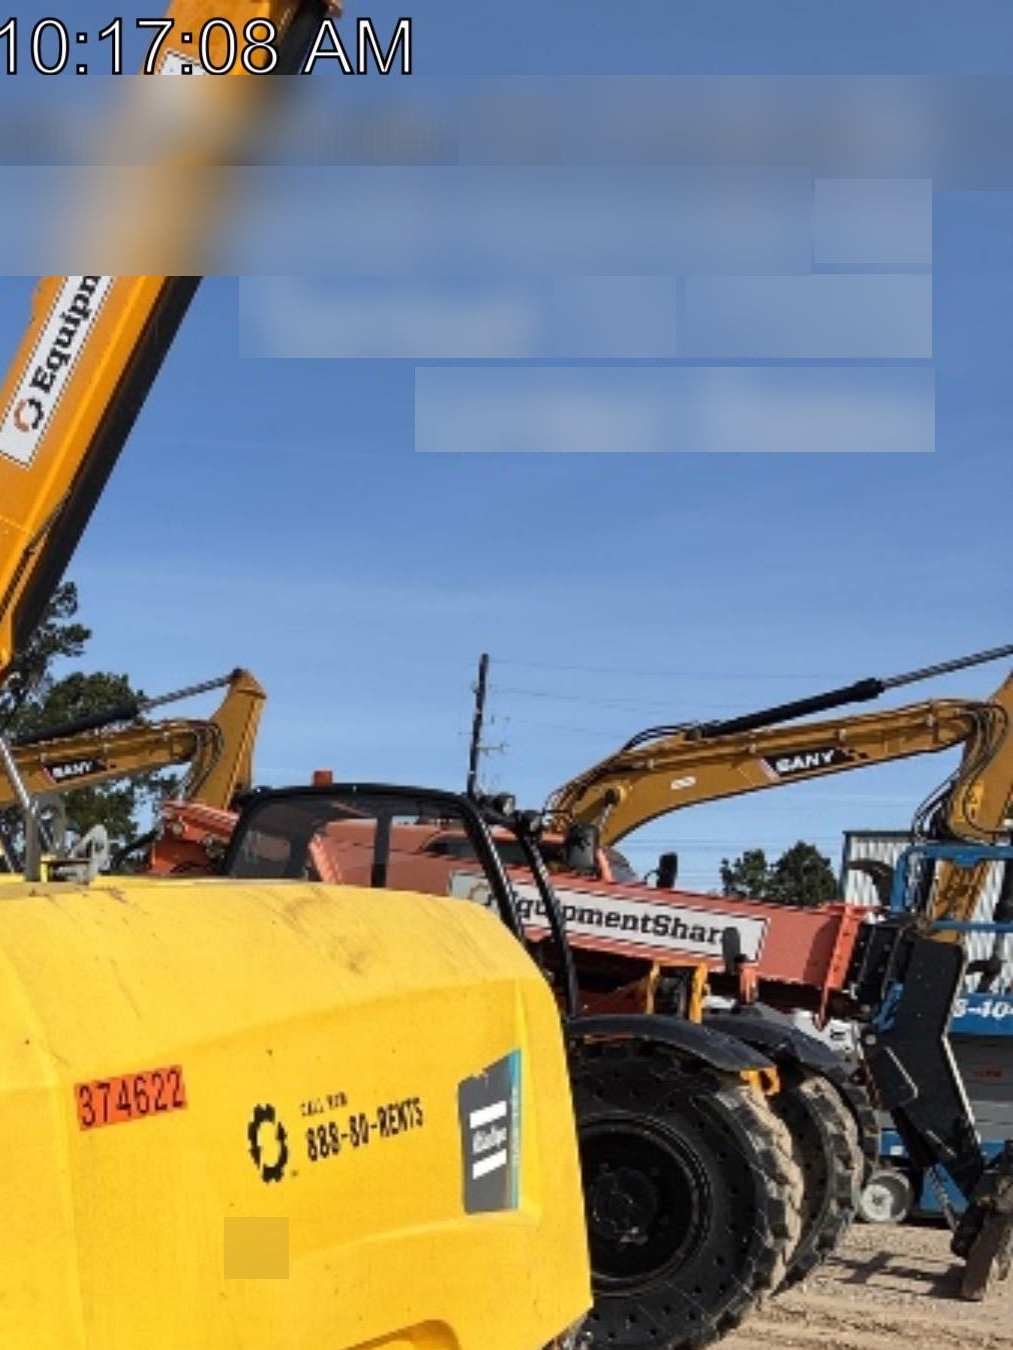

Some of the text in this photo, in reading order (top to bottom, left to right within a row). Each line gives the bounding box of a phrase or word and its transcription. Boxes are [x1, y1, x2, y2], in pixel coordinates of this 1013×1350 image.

[52, 761, 93, 778] SANY
[775, 749, 835, 773] SANY
[79, 1068, 184, 1127] 374622
[306, 1096, 424, 1162] 888-80-RENTS
